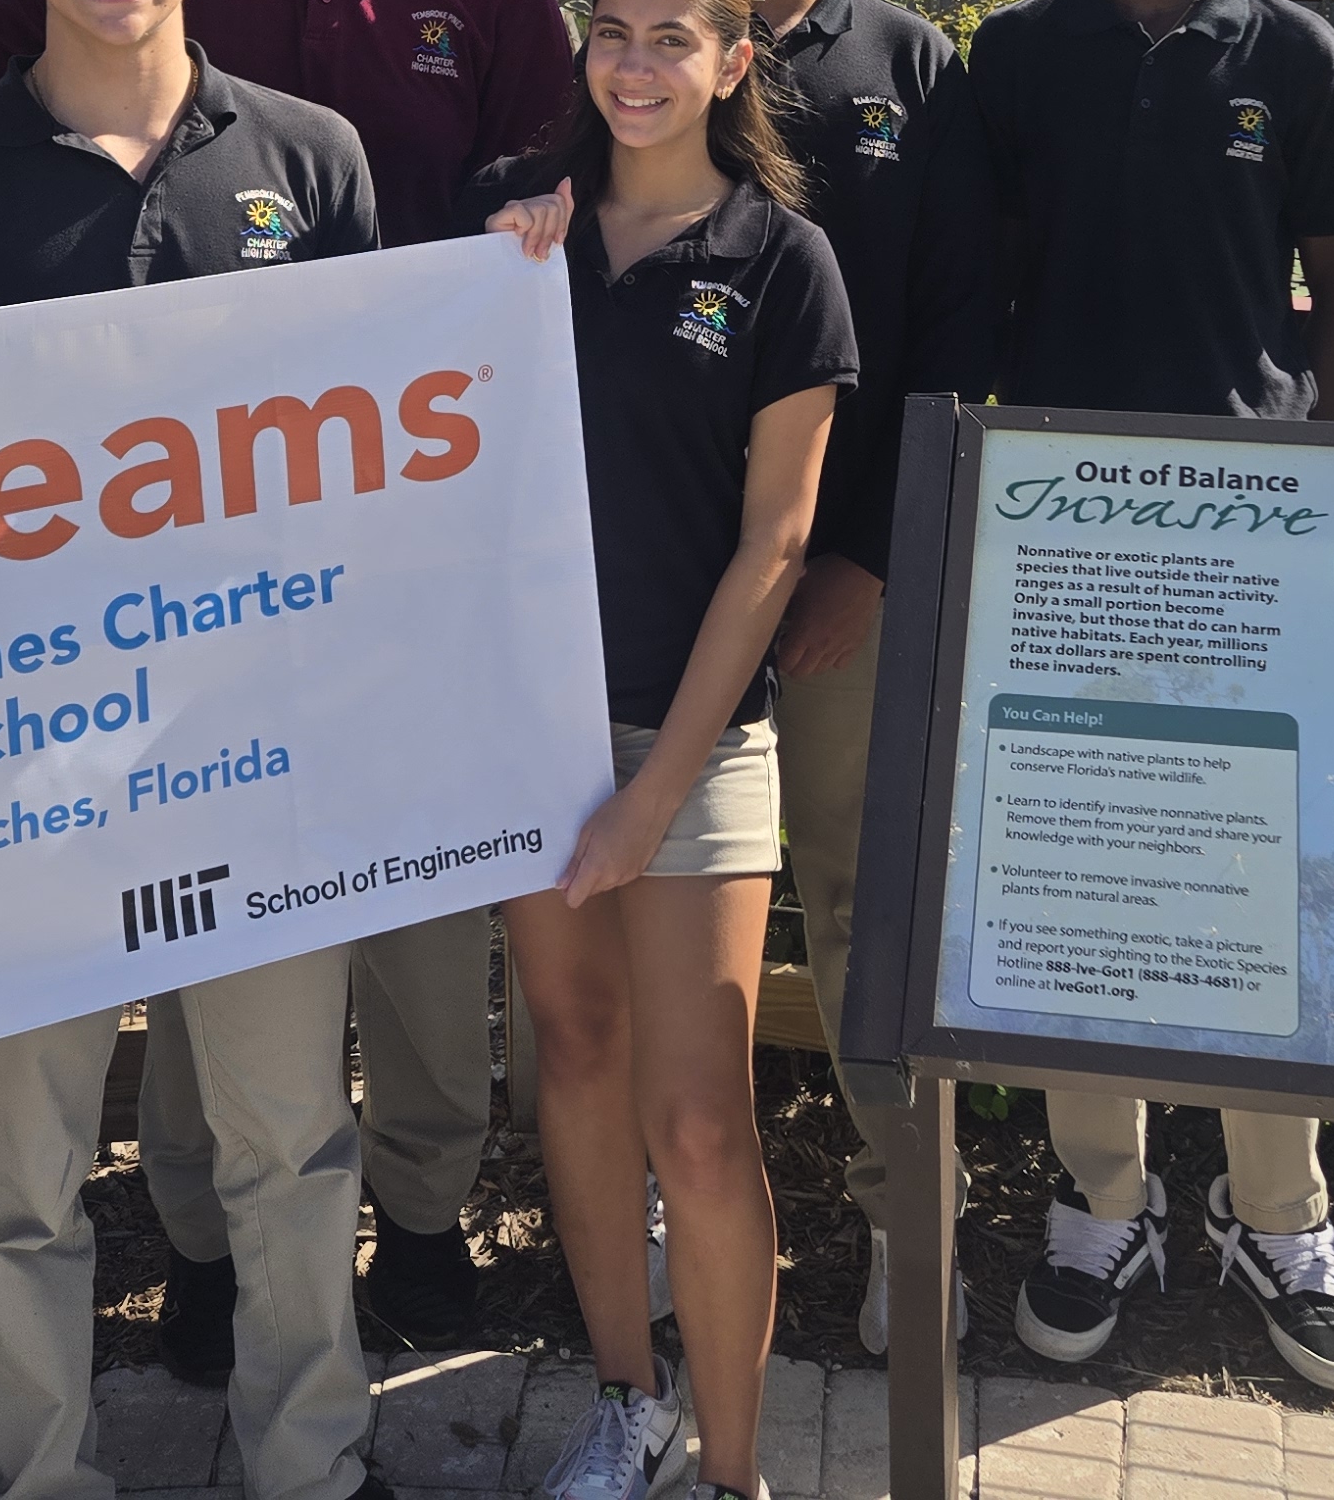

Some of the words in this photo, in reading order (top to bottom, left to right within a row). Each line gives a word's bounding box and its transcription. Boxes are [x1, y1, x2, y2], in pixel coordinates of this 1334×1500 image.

[411, 61, 430, 73] HIGH
[431, 66, 459, 78] SCHOOL
[417, 54, 454, 67] CHARTER
[247, 238, 288, 250] CHARTER
[673, 326, 696, 341] HIGH
[1075, 460, 1131, 485] Out
[1139, 463, 1172, 486] of
[1178, 464, 1299, 492] Balance
[995, 476, 1329, 535] Invasive
[1017, 543, 1092, 559] Nonnative
[1094, 550, 1110, 561] or
[1113, 550, 1158, 563] exotic
[1160, 552, 1207, 567] plants
[1210, 557, 1235, 568] are
[1015, 561, 1068, 576] species
[1071, 563, 1102, 577] that
[1104, 564, 1131, 578] live
[1134, 568, 1190, 581] outside
[1193, 569, 1228, 583] their
[1232, 572, 1280, 586] native
[1014, 591, 1047, 609] Only
[1050, 597, 1060, 606] a
[1062, 595, 1102, 609] small
[1104, 598, 1161, 613] portion
[1164, 600, 1225, 616] become
[1015, 579, 1064, 593] ranges
[1066, 581, 1083, 592] as
[1085, 582, 1095, 592] a
[1097, 581, 1140, 595] result
[1143, 583, 1159, 596] of
[1162, 584, 1214, 599] human
[1217, 588, 1279, 605] activity.
[103, 564, 344, 650] Charter
[1012, 607, 1075, 627] invasive,
[1079, 611, 1105, 625] but
[1108, 614, 1150, 628] those
[1153, 616, 1184, 630] that
[1187, 618, 1207, 631] do
[1210, 622, 1237, 633] can
[1240, 621, 1282, 636] harm
[1011, 626, 1057, 639] native
[1060, 627, 1125, 643] habitats.
[1128, 631, 1164, 646] Each
[1167, 636, 1203, 651] year,
[1206, 636, 1268, 652] millions
[1009, 657, 1049, 671] these
[1052, 659, 1122, 676] invaders.
[1010, 640, 1025, 653] of
[1028, 642, 1052, 655] tax
[1054, 643, 1106, 658] dollars
[1109, 649, 1133, 660] are
[1136, 650, 1179, 664] spent
[1182, 653, 1267, 671] controlling
[1002, 706, 1029, 721] You
[1031, 708, 1060, 723] Can
[1063, 710, 1104, 729] Help!
[1010, 742, 1075, 762] Landscape
[1076, 747, 1104, 760] with
[1106, 749, 1144, 763] native
[1146, 751, 1185, 767] plants
[1186, 754, 1200, 767] to
[1202, 754, 1231, 772] help
[128, 738, 291, 813] Florida
[1009, 761, 1064, 774] conserve
[1117, 767, 1156, 781] native
[1158, 769, 1207, 784] wildlife.
[1006, 793, 1041, 808] Learn
[1043, 797, 1057, 810] to
[1058, 797, 1105, 817] identify
[1107, 801, 1158, 817] invasive
[1159, 808, 1223, 822] nonnative
[1225, 810, 1268, 827] plants.
[1005, 827, 1074, 848] knowledge
[1076, 833, 1104, 847] with
[1106, 838, 1135, 852] your
[1137, 838, 1206, 856] neighbors.
[1006, 810, 1056, 826] Remove
[1058, 814, 1092, 828] them
[1093, 816, 1124, 831] from
[1126, 822, 1154, 835] your
[1157, 823, 1185, 838] yard
[1187, 825, 1212, 838] and
[1214, 826, 1249, 841] share
[1251, 832, 1282, 845] your
[246, 871, 347, 920] School
[352, 863, 379, 893] of
[384, 828, 543, 885] Engineering
[1001, 864, 1061, 881] Volunteer
[1064, 870, 1078, 882] to
[1079, 873, 1128, 886] remove
[1129, 874, 1181, 890] invasive
[1183, 881, 1250, 896] nonnative
[1001, 881, 1040, 897] plants
[1041, 884, 1072, 899] from
[1074, 889, 1119, 903] natural
[1121, 894, 1159, 906] areas.
[998, 918, 1006, 932] If
[1008, 922, 1033, 936] you
[1035, 925, 1057, 936] see
[1059, 927, 1128, 945] something
[1130, 932, 1171, 949] exotic,
[1174, 935, 1203, 948] take
[1204, 939, 1213, 949] a
[1215, 938, 1264, 954] picture
[997, 937, 1022, 950] and
[1024, 942, 1065, 956] report
[1066, 945, 1095, 959] your
[1098, 946, 1151, 966] sighting
[1153, 951, 1168, 964] to
[1170, 953, 1193, 966] the
[1194, 954, 1234, 970] Exotic
[1237, 958, 1288, 975] Species
[995, 974, 1035, 989] online
[1037, 979, 1050, 991] at
[996, 954, 1042, 971] Hotline
[1246, 980, 1261, 991] or
